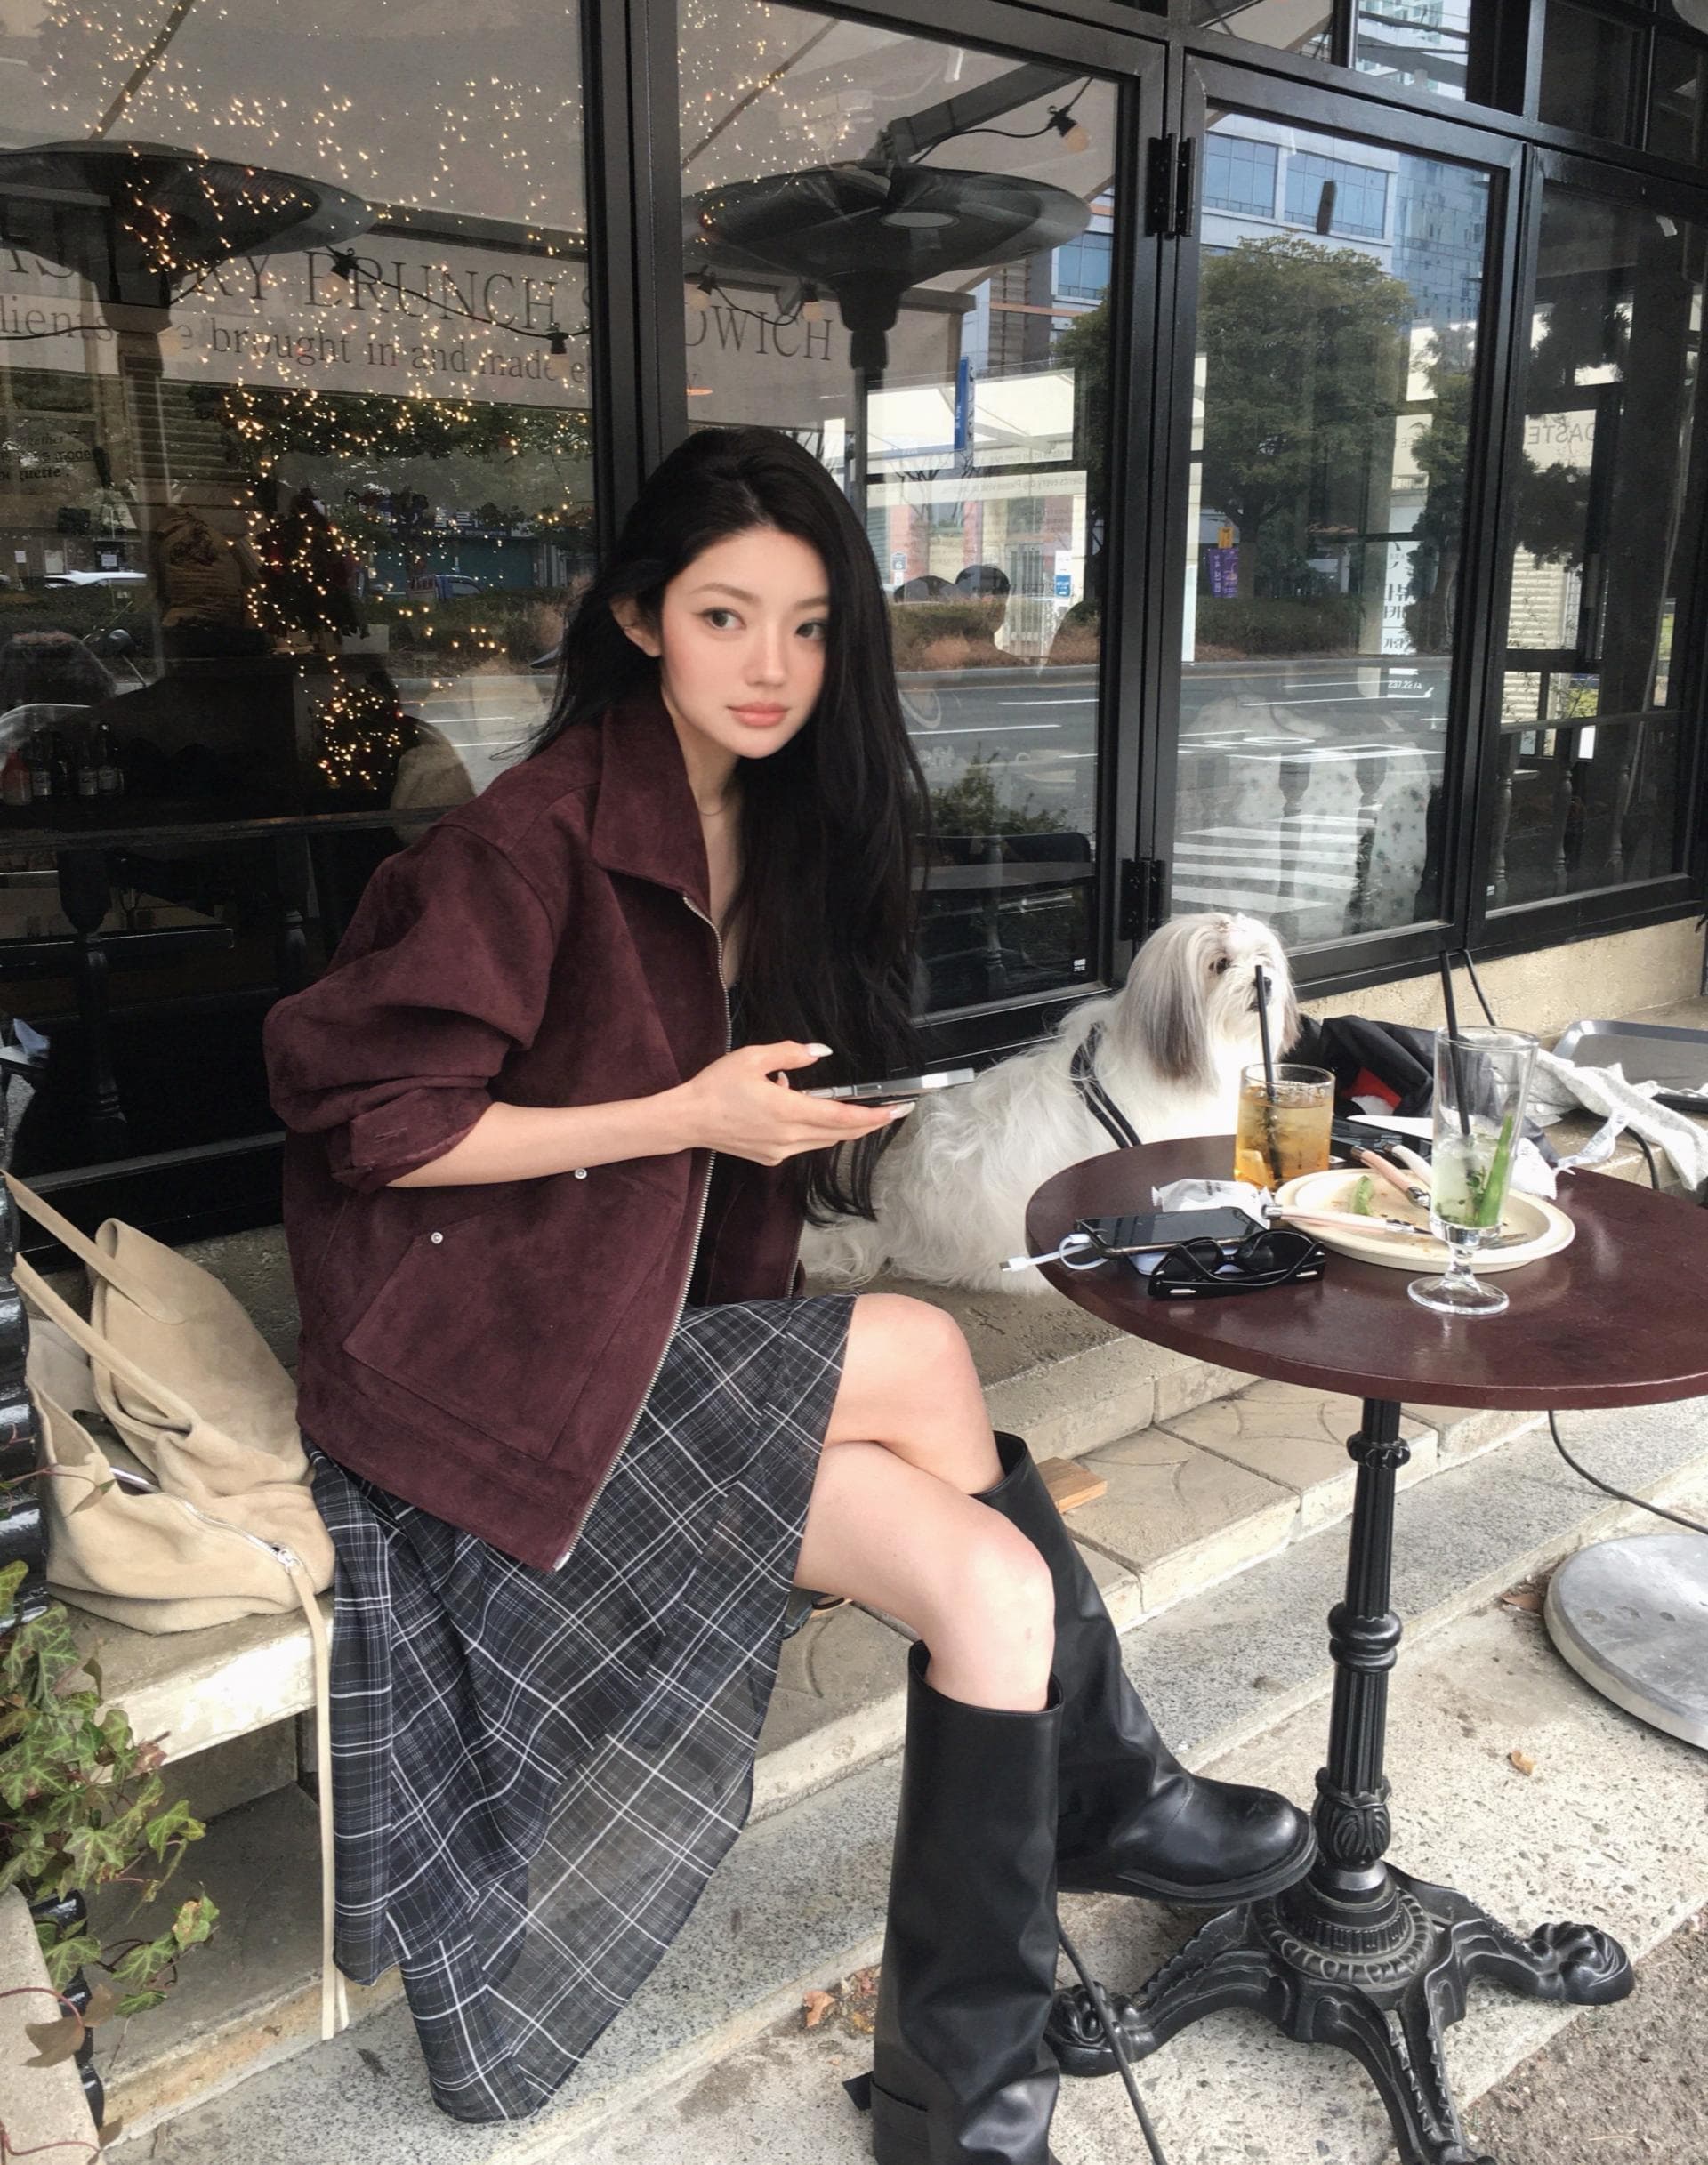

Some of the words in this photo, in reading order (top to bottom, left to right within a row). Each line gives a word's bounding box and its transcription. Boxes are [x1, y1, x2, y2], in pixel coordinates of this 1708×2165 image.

[212, 317, 351, 366] brought
[367, 332, 398, 366] in
[411, 341, 468, 373] and
